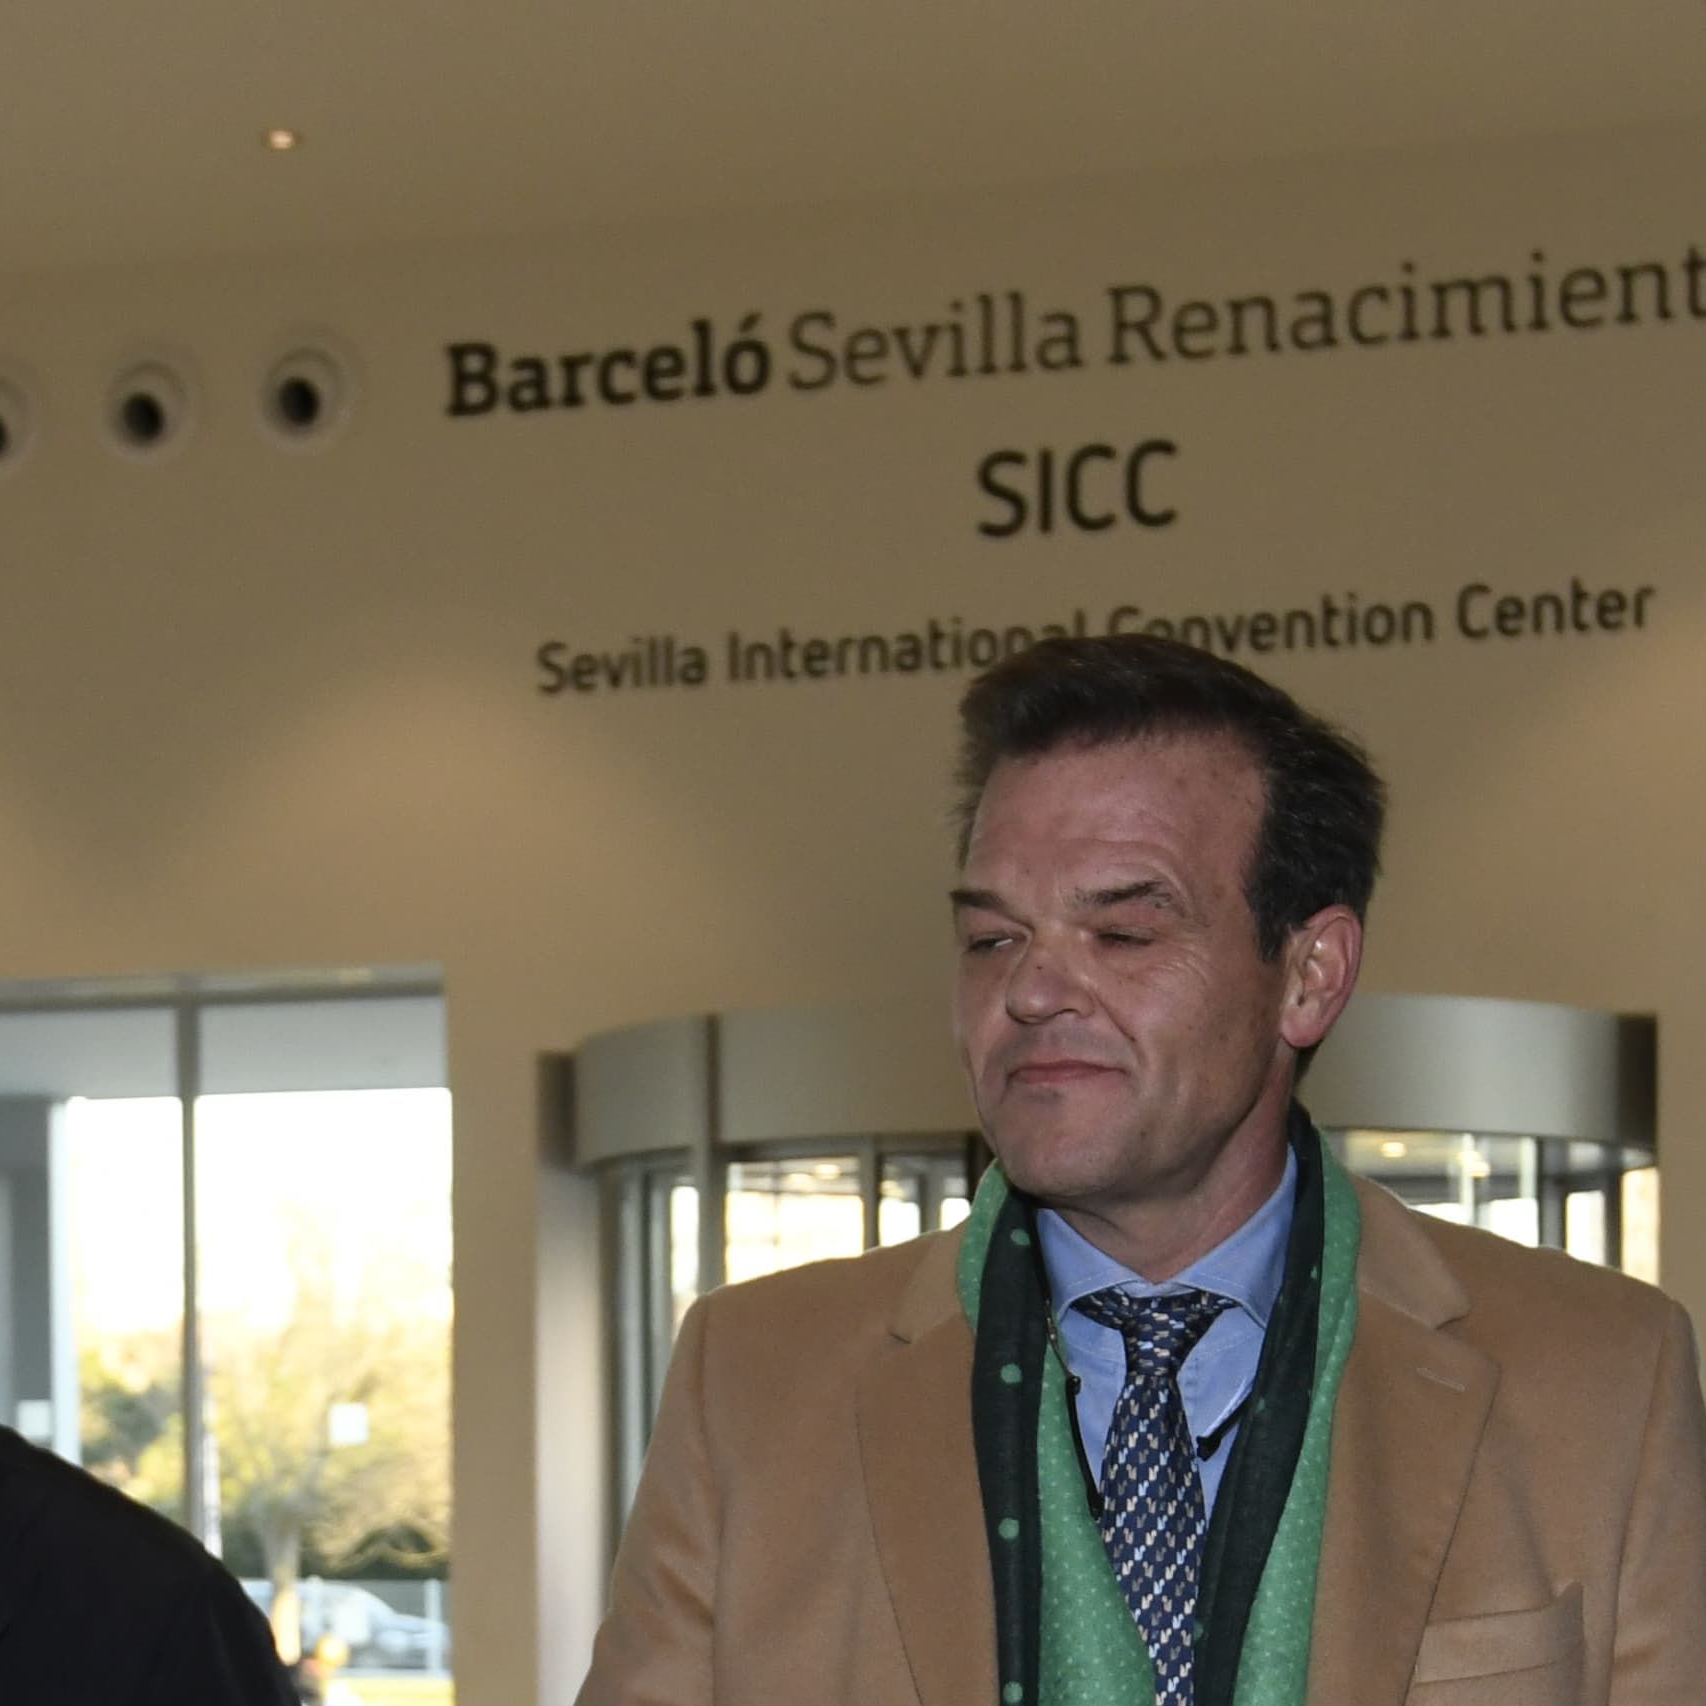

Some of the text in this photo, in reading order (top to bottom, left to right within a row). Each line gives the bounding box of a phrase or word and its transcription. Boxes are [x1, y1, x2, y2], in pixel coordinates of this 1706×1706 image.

[446, 313, 771, 417] Barceló
[787, 291, 1084, 392] Sevilla
[977, 438, 1178, 539] SICC
[536, 635, 709, 695] Sevilla
[728, 606, 1086, 682] Internationl
[1456, 577, 1655, 641] Center
